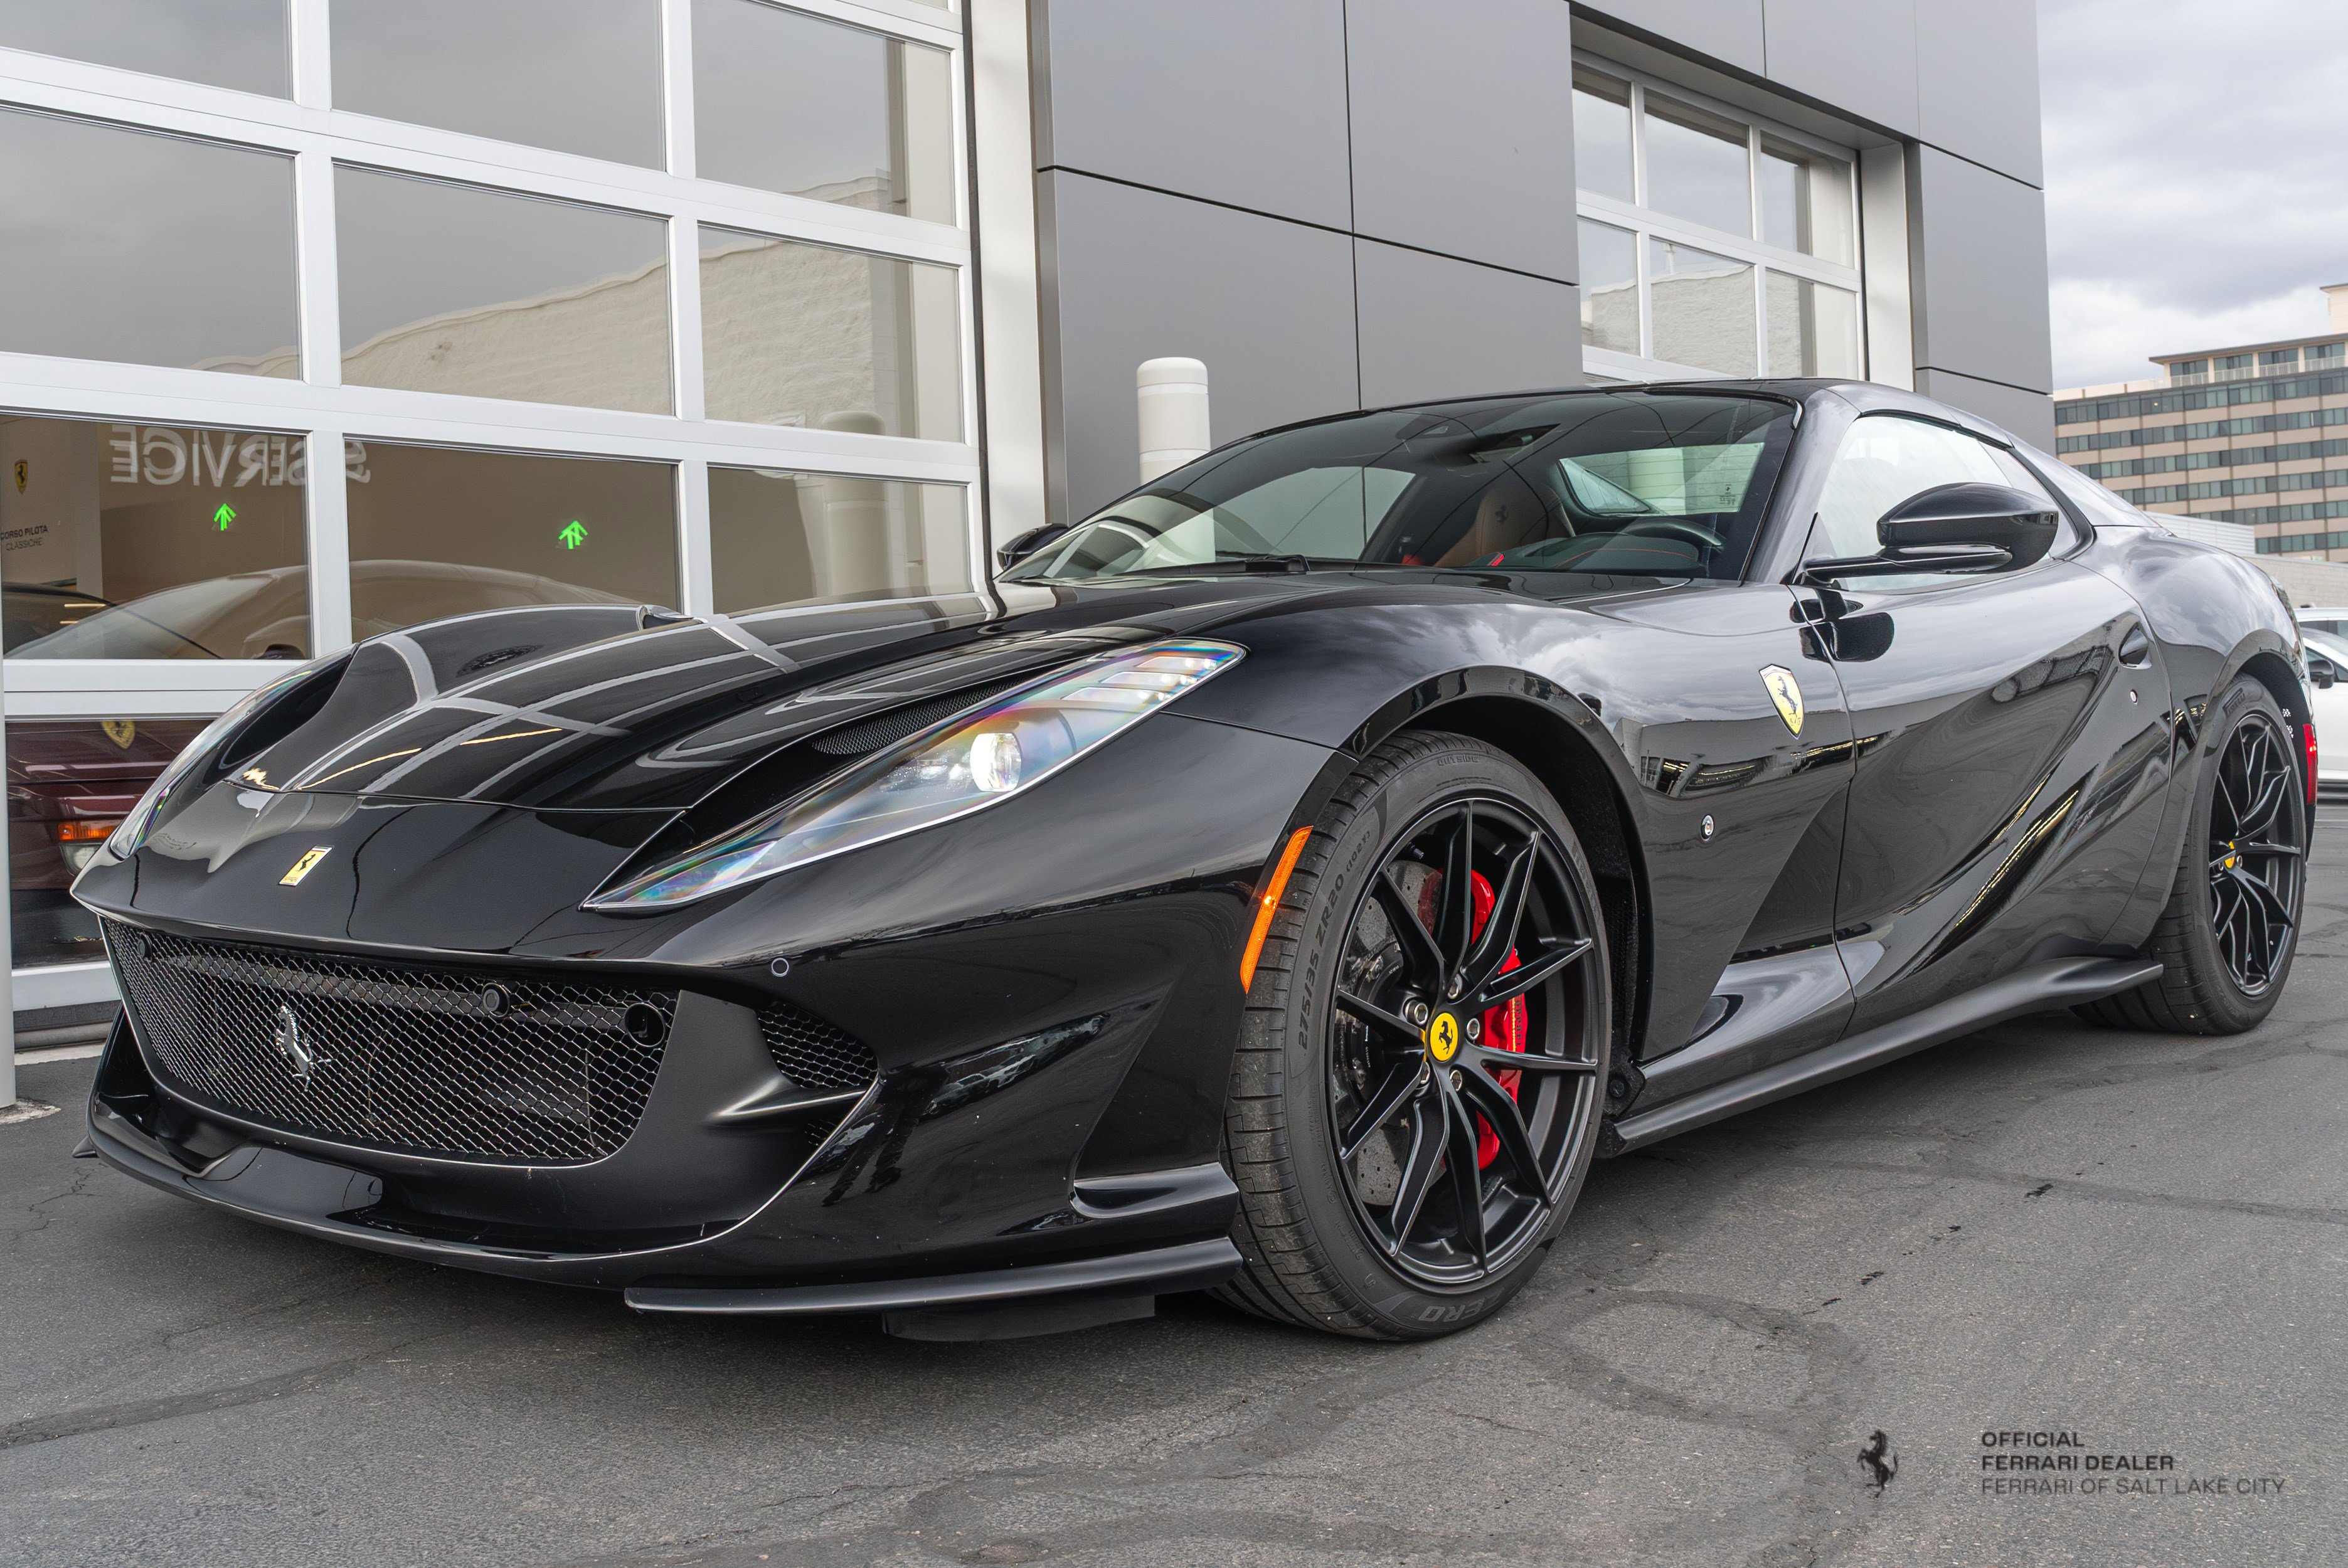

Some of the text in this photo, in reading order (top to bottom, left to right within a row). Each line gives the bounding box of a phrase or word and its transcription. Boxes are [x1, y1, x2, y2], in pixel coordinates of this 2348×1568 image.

[1, 525, 48, 540] CORSO PILOTA
[1298, 949, 1319, 1051] 275/35
[1315, 873, 1345, 948] ZR20
